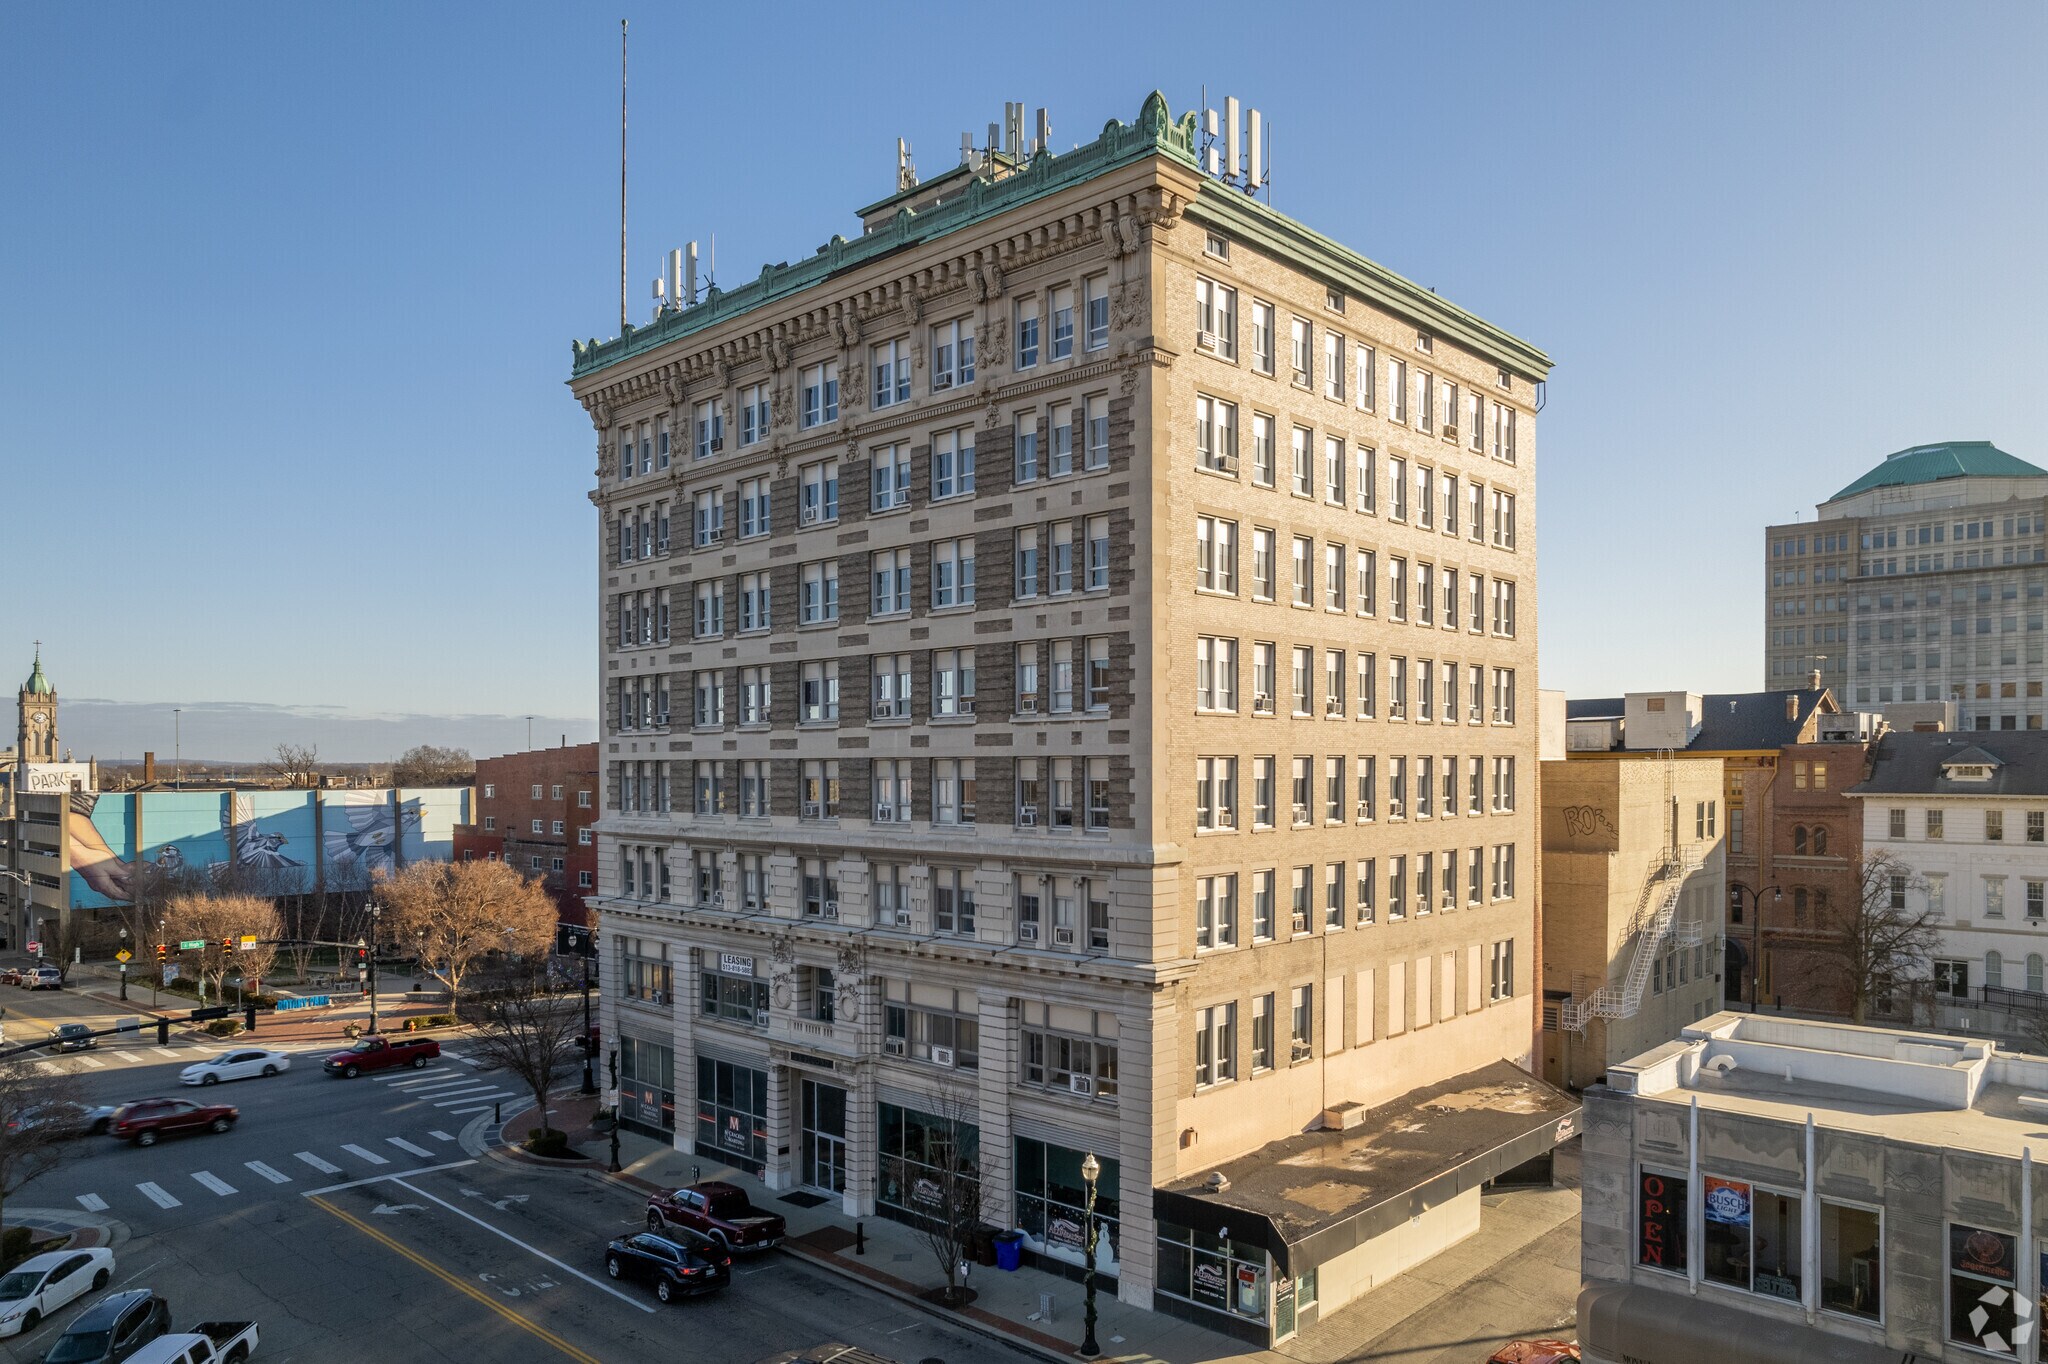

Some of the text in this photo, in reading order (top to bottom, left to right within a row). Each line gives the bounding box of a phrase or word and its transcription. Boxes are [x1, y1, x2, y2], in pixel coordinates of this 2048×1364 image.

[723, 954, 752, 967] LEASING
[277, 995, 330, 1010] ROTARY PARK
[1709, 1193, 1745, 1209] BUSCH
[1717, 1205, 1737, 1214] LIGHT
[1643, 1176, 1665, 1265] OPEN
